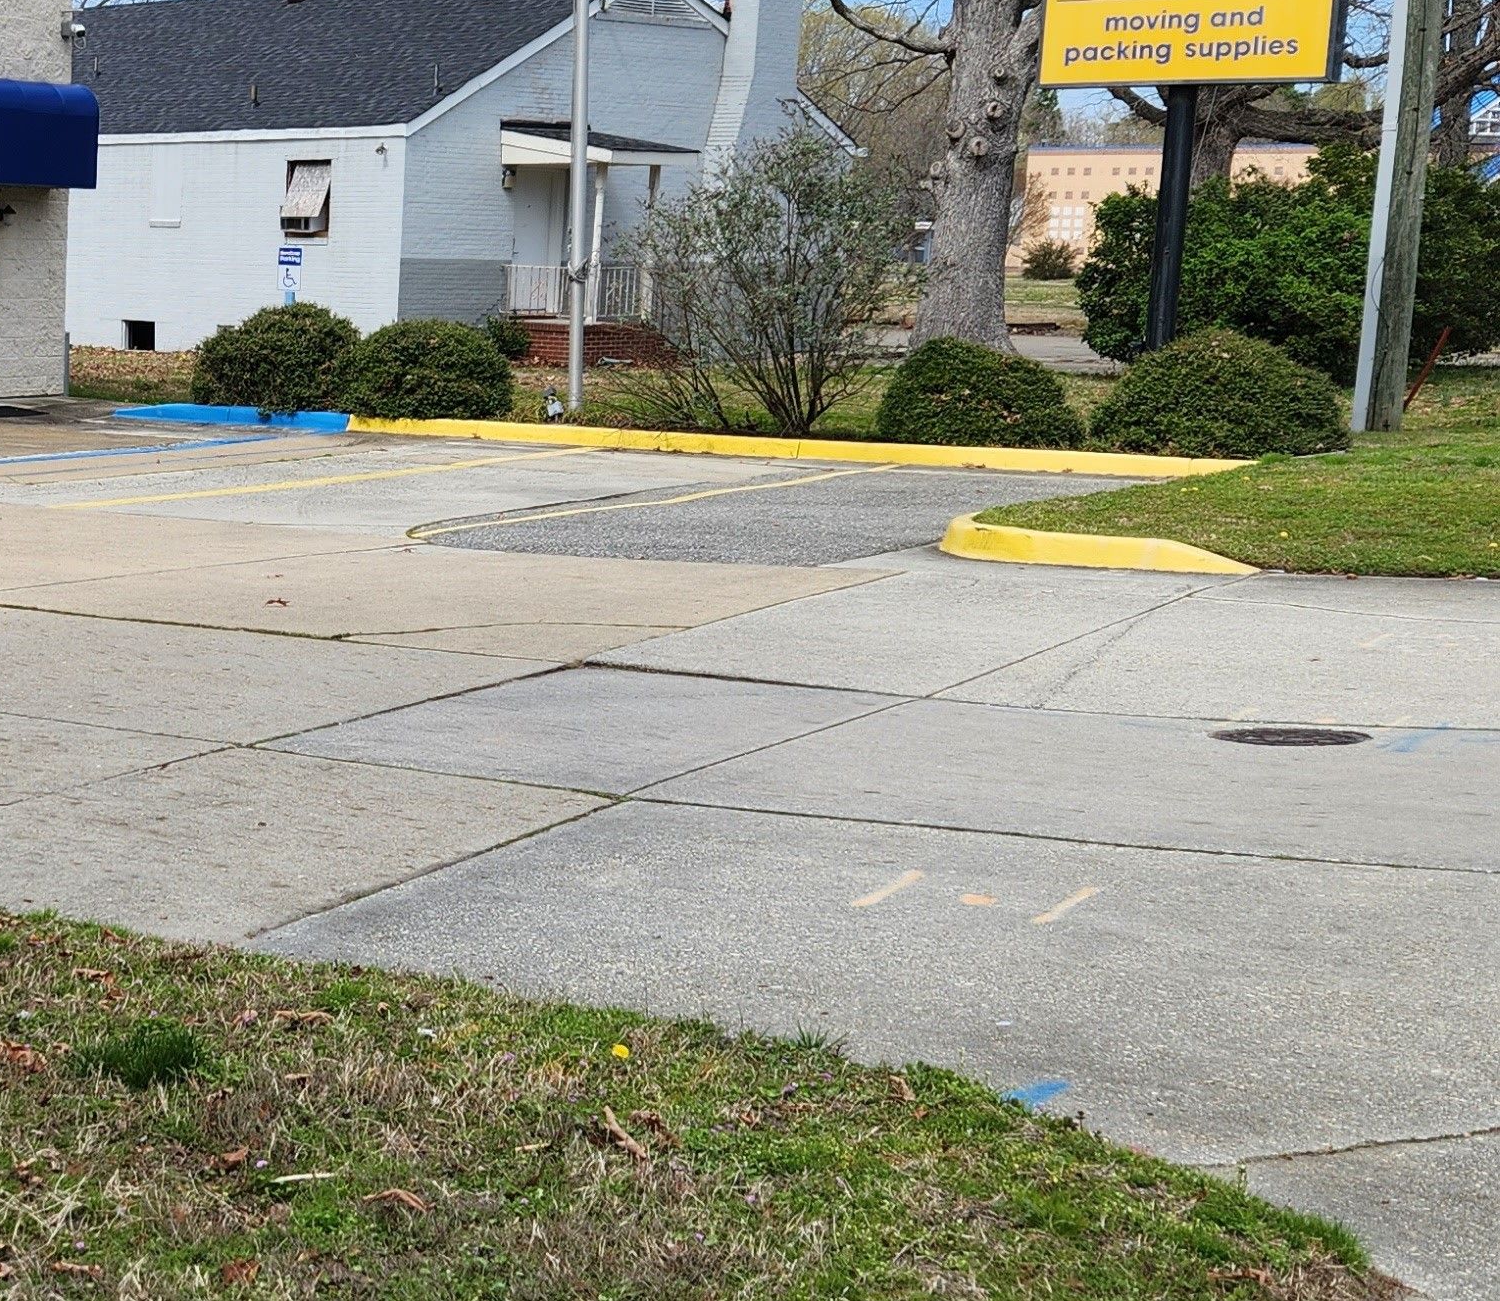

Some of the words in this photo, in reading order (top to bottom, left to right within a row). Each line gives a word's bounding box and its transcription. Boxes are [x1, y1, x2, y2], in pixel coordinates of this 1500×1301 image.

[1105, 10, 1200, 34] moving
[1210, 6, 1265, 28] and
[1064, 41, 1172, 66] packing
[1185, 36, 1299, 61] supplies
